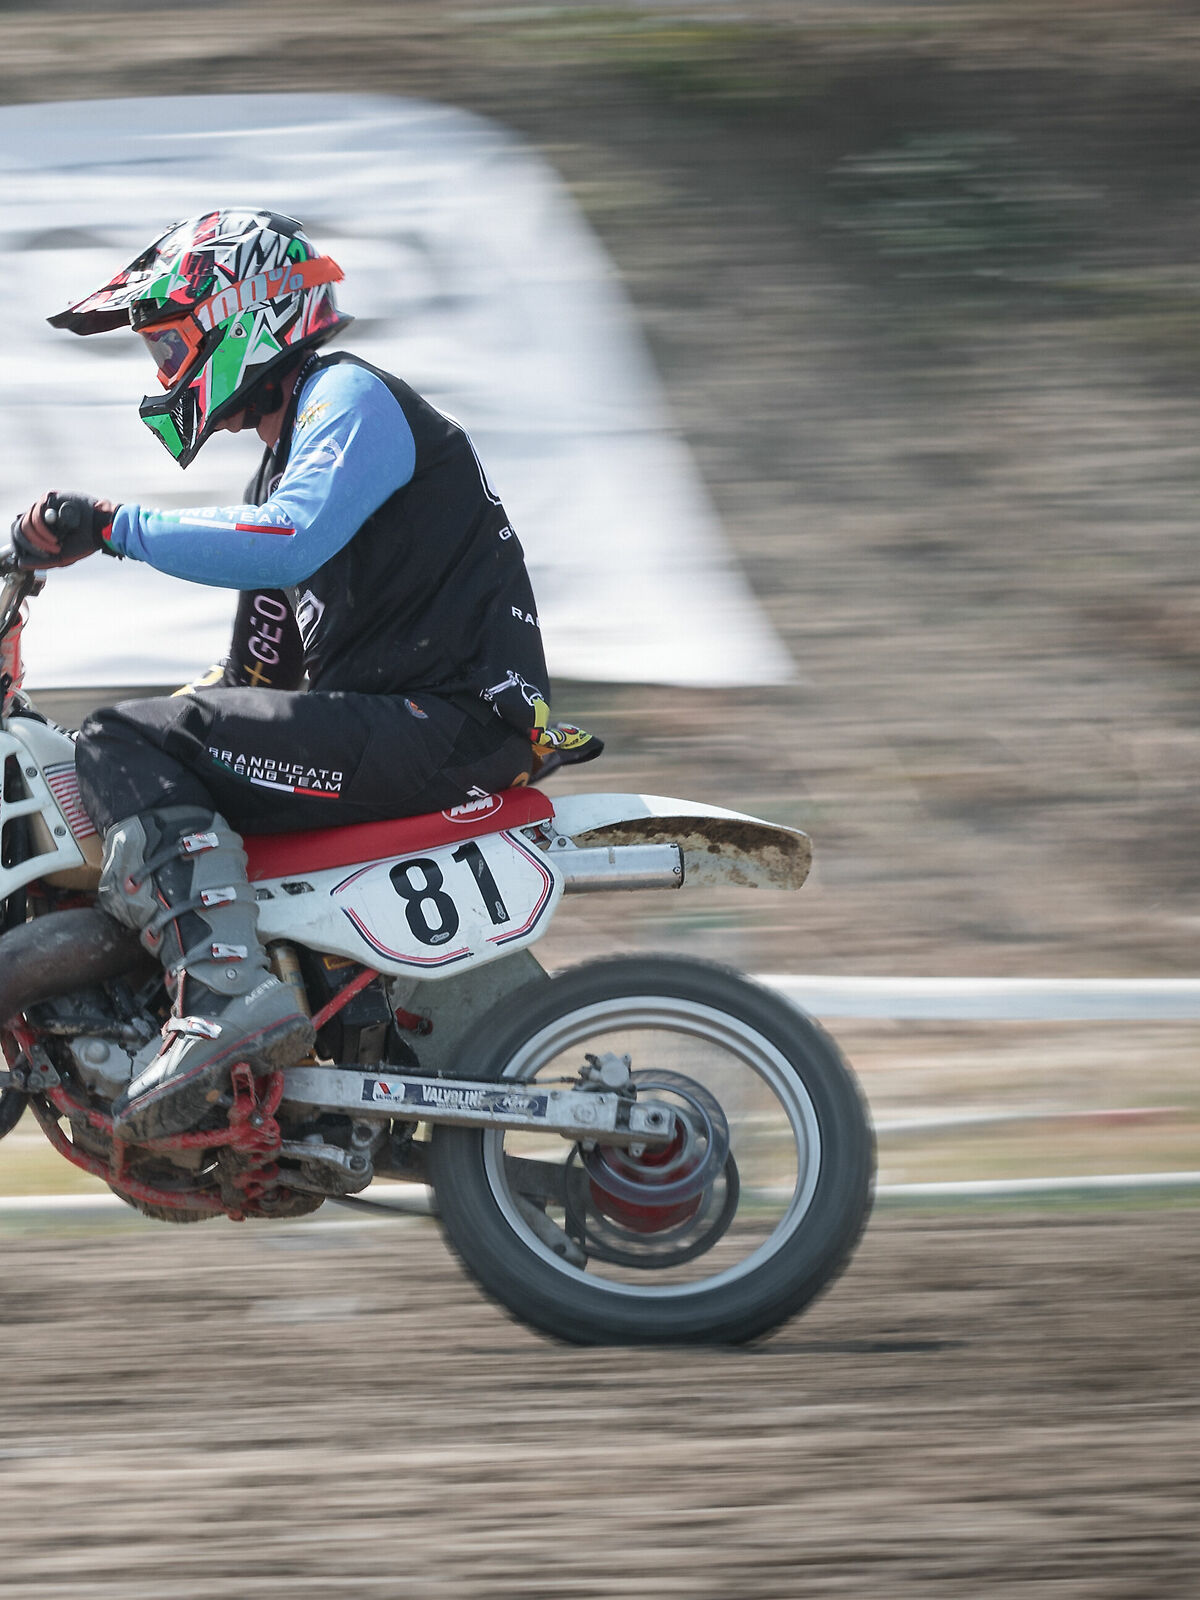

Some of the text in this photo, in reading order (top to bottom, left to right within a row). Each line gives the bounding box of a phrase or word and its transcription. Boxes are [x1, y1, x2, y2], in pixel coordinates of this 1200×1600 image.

[198, 265, 303, 332] 100%
[286, 773, 342, 791] TEAM
[388, 840, 511, 946] 81
